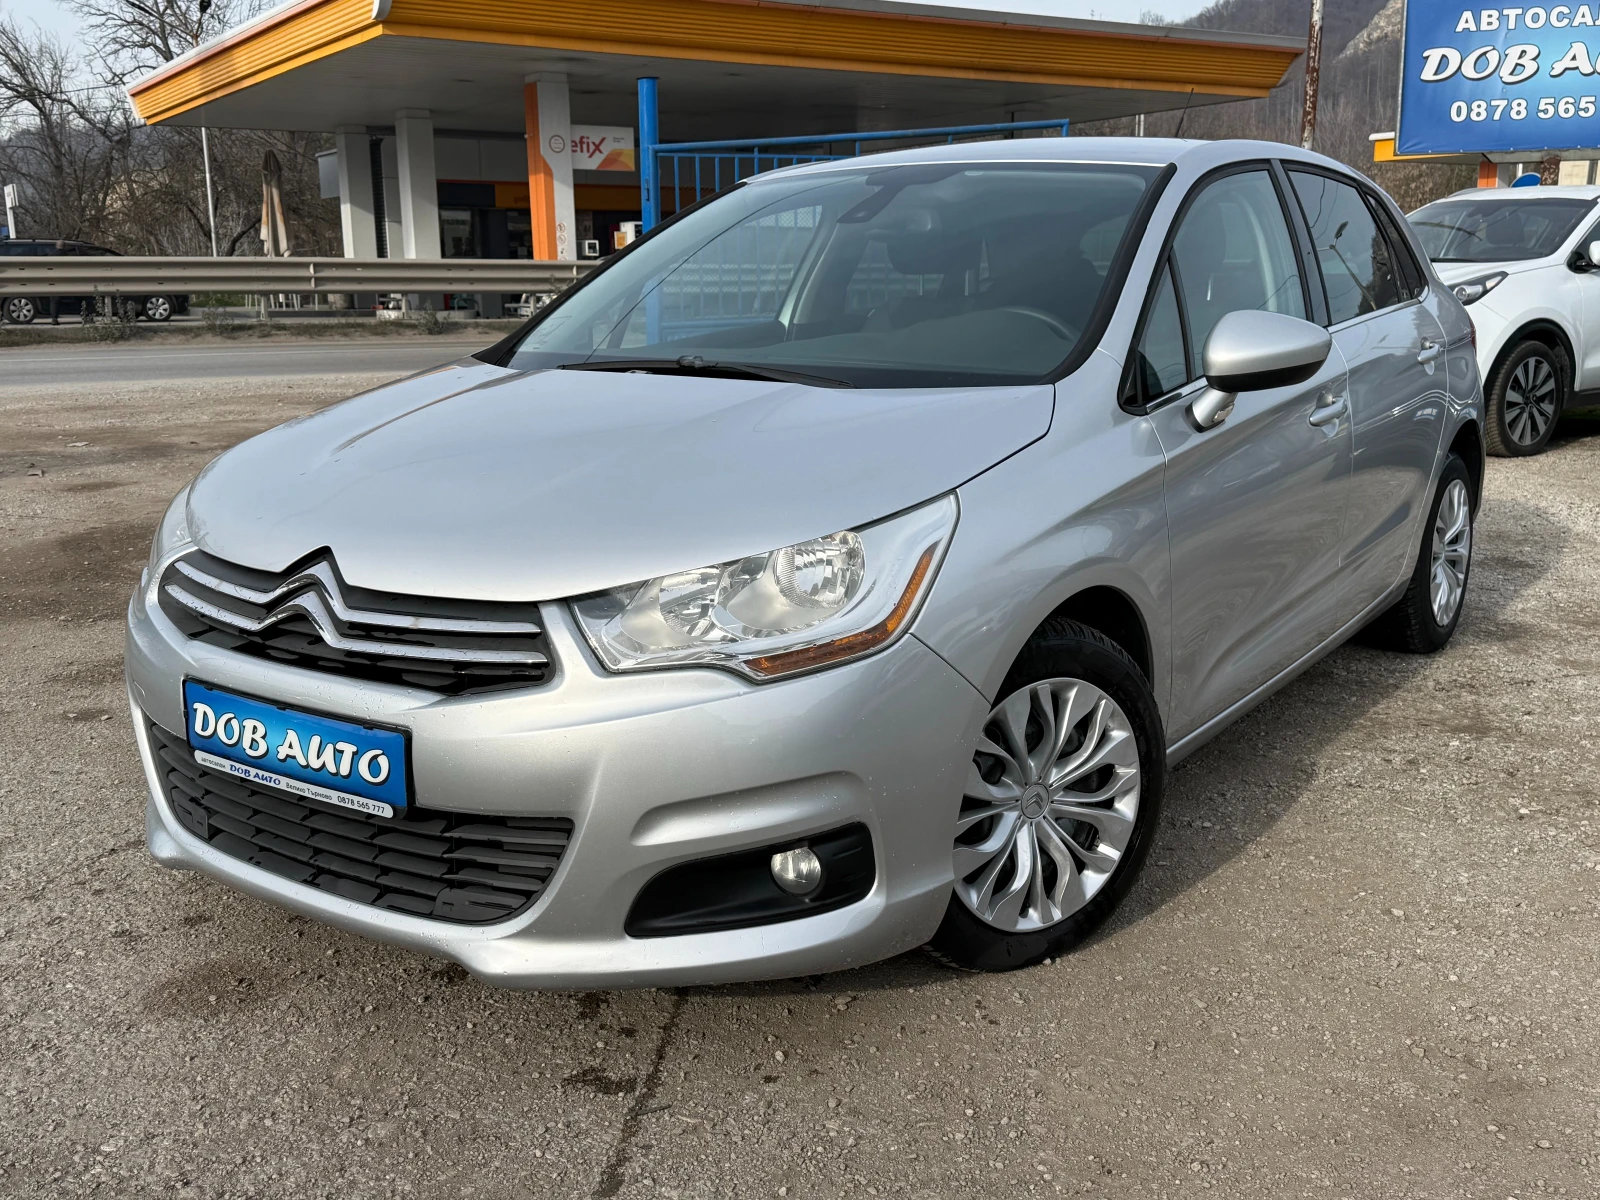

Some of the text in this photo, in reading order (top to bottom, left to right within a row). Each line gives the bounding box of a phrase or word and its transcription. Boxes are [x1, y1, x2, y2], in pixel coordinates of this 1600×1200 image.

[1420, 44, 1540, 84] DOB
[1450, 96, 1596, 122] 0878 565
[193, 702, 391, 785] DOB AUTO
[229, 763, 251, 778] DOB
[253, 773, 281, 786] AUTO
[285, 782, 306, 794] Велико
[306, 788, 333, 801] Търново
[337, 795, 355, 807] 0878
[356, 800, 370, 811] 565
[372, 804, 385, 814] 777
